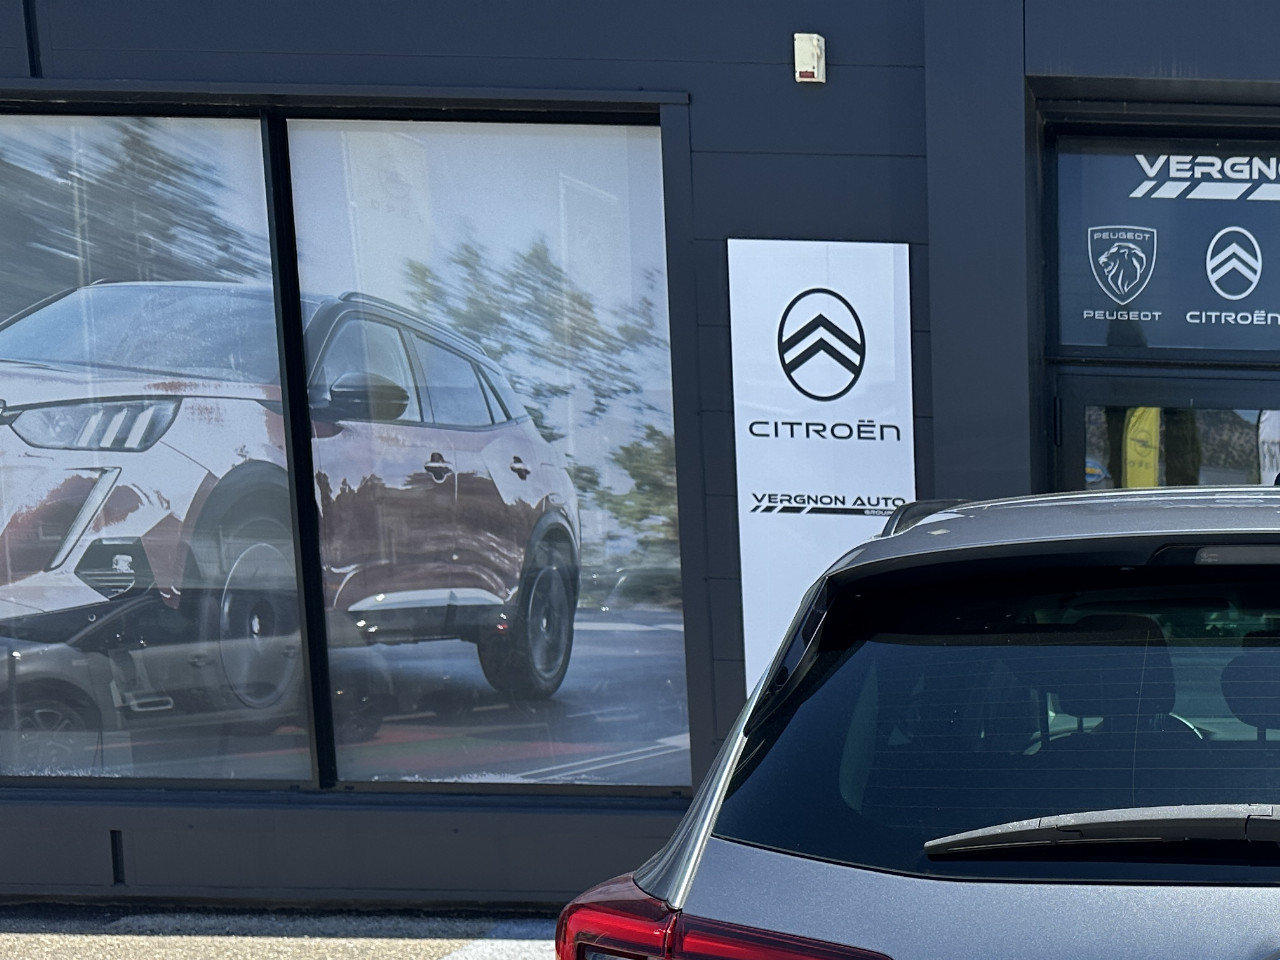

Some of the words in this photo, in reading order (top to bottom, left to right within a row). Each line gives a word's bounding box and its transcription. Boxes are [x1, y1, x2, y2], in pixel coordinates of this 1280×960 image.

[1094, 231, 1151, 241] PEUGEOT
[1083, 310, 1163, 322] PEUGEOT
[752, 493, 846, 505] VERGNON
[852, 496, 906, 509] AUTO
